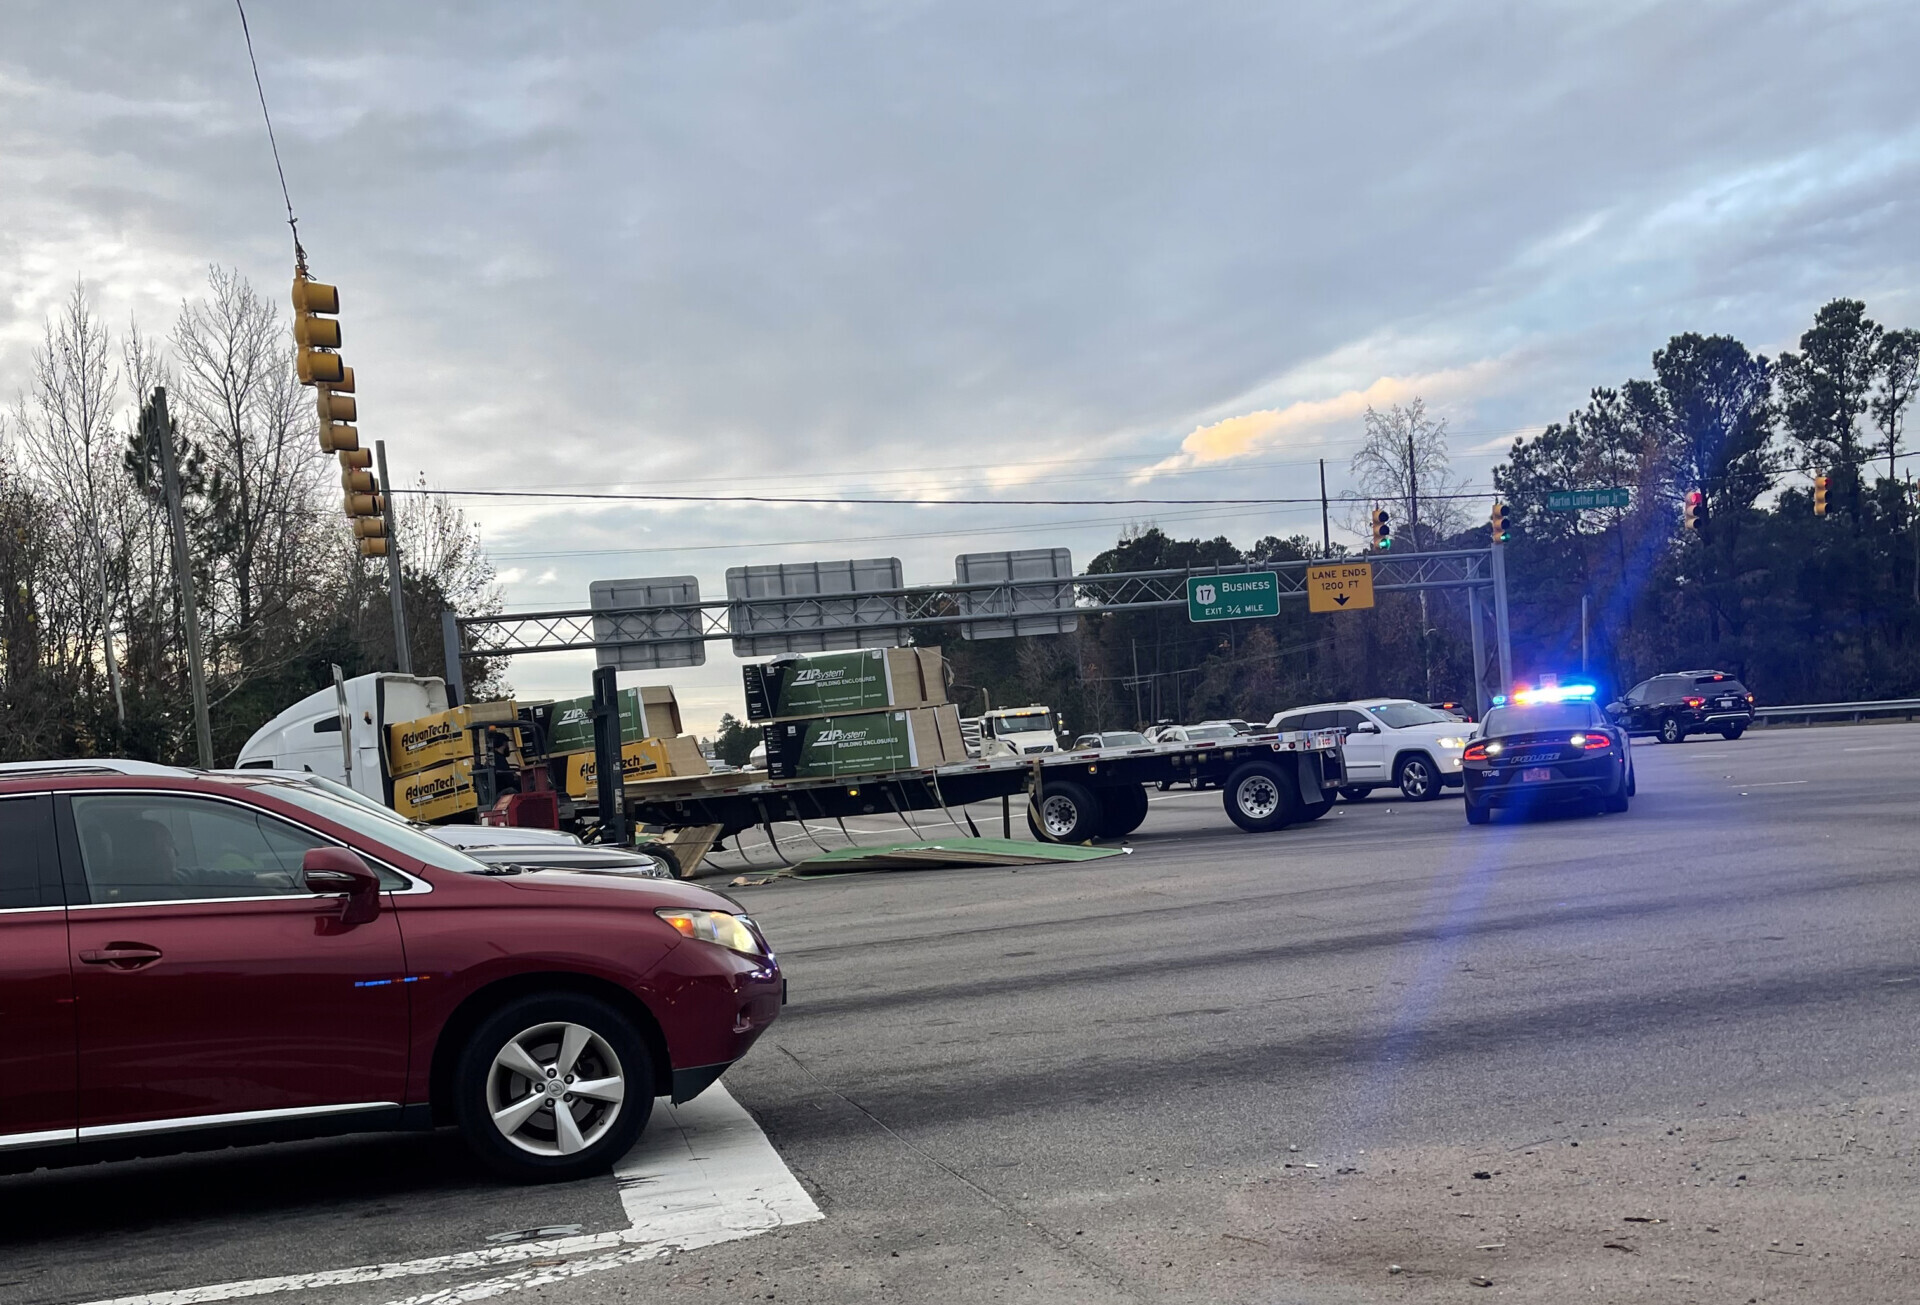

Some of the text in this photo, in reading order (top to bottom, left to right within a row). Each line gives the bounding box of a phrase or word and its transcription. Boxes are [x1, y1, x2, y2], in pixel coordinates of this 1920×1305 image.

[1549, 496, 1571, 507] Martin
[1572, 494, 1594, 506] Luther
[1596, 493, 1610, 505] King
[1312, 568, 1367, 580] LANE ENDS
[1321, 580, 1359, 591] 1200 FT
[1200, 589, 1212, 601] 17
[1205, 607, 1223, 616] EXIT
[1244, 604, 1264, 613] MILE
[817, 675, 877, 688] BUILDING ENCLOSURES
[401, 721, 450, 748] AdvanTech
[838, 737, 899, 748] BUILDING ENCLOSURES
[1510, 752, 1561, 764] POLICE
[405, 774, 455, 801] AdvanTech
